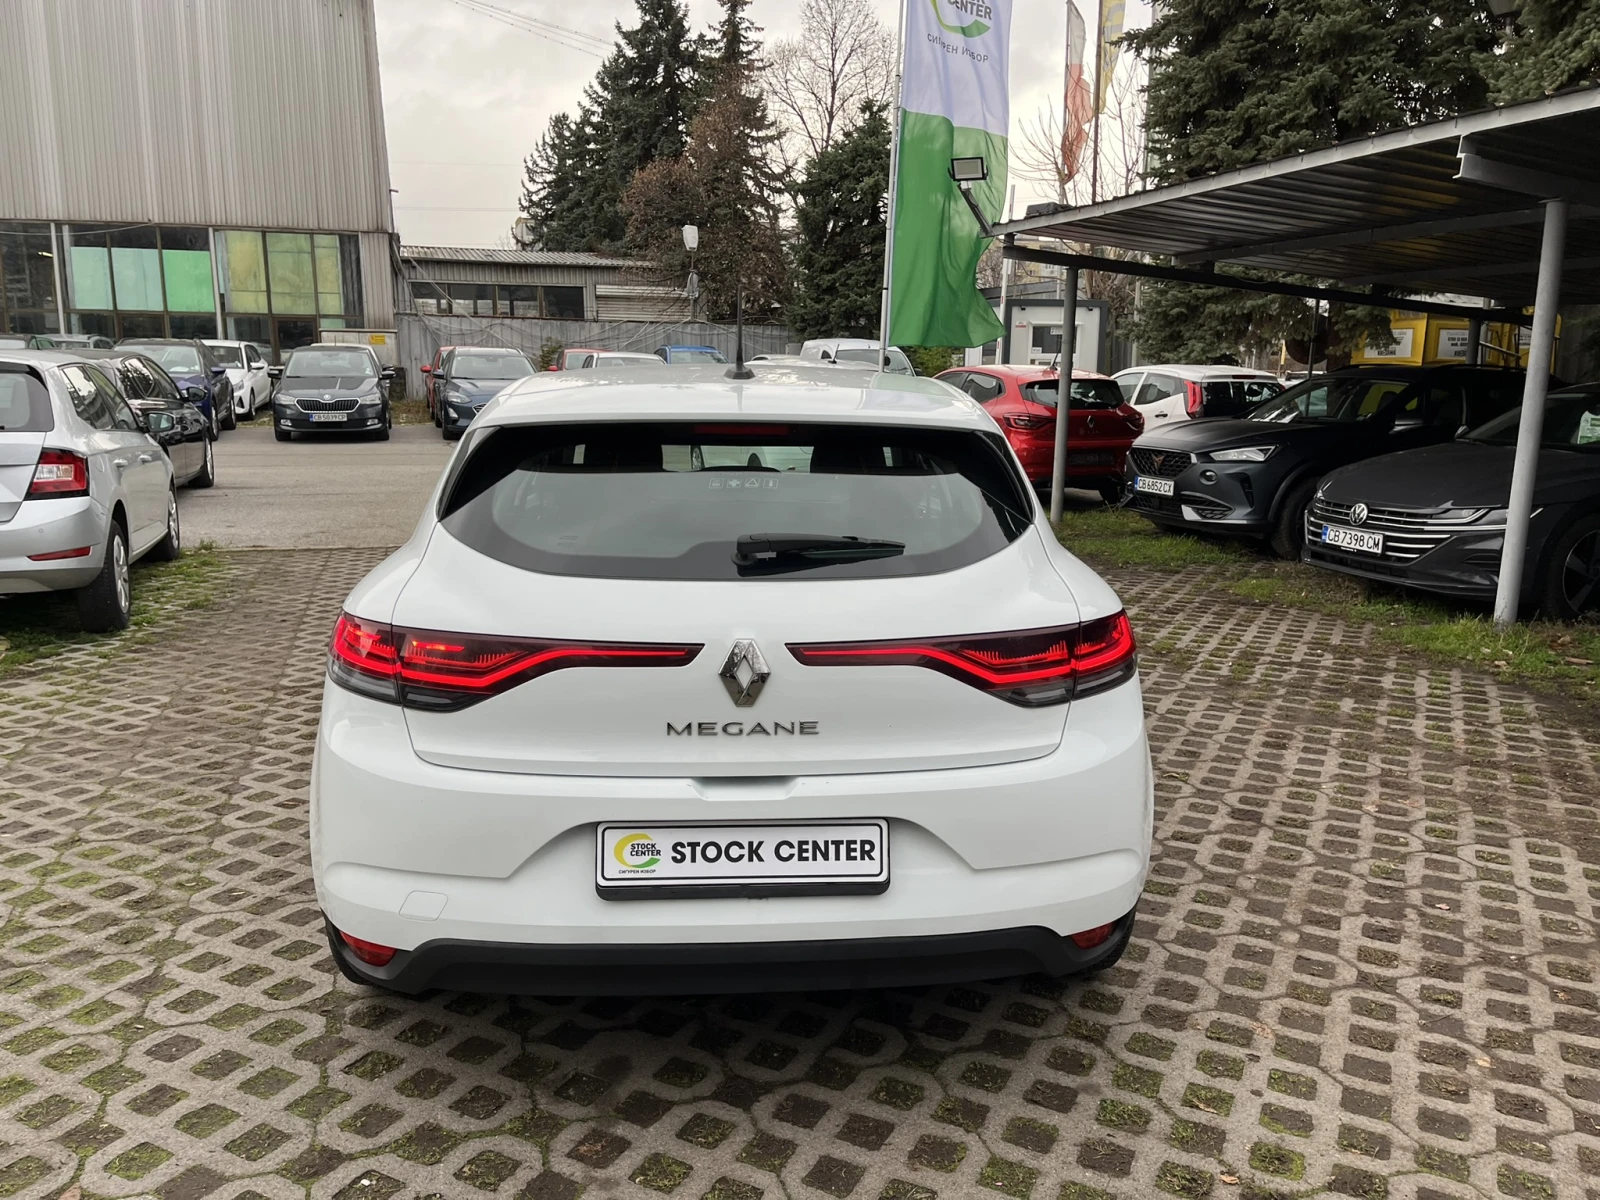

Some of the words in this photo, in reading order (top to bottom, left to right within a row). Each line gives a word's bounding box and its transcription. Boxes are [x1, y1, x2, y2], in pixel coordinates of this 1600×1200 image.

[1341, 531, 1365, 548] 7398
[666, 720, 820, 736] MEGANE
[630, 842, 657, 850] STOCK
[630, 849, 662, 857] CENTER
[671, 840, 765, 864] STOCK
[774, 839, 876, 862] CENTER
